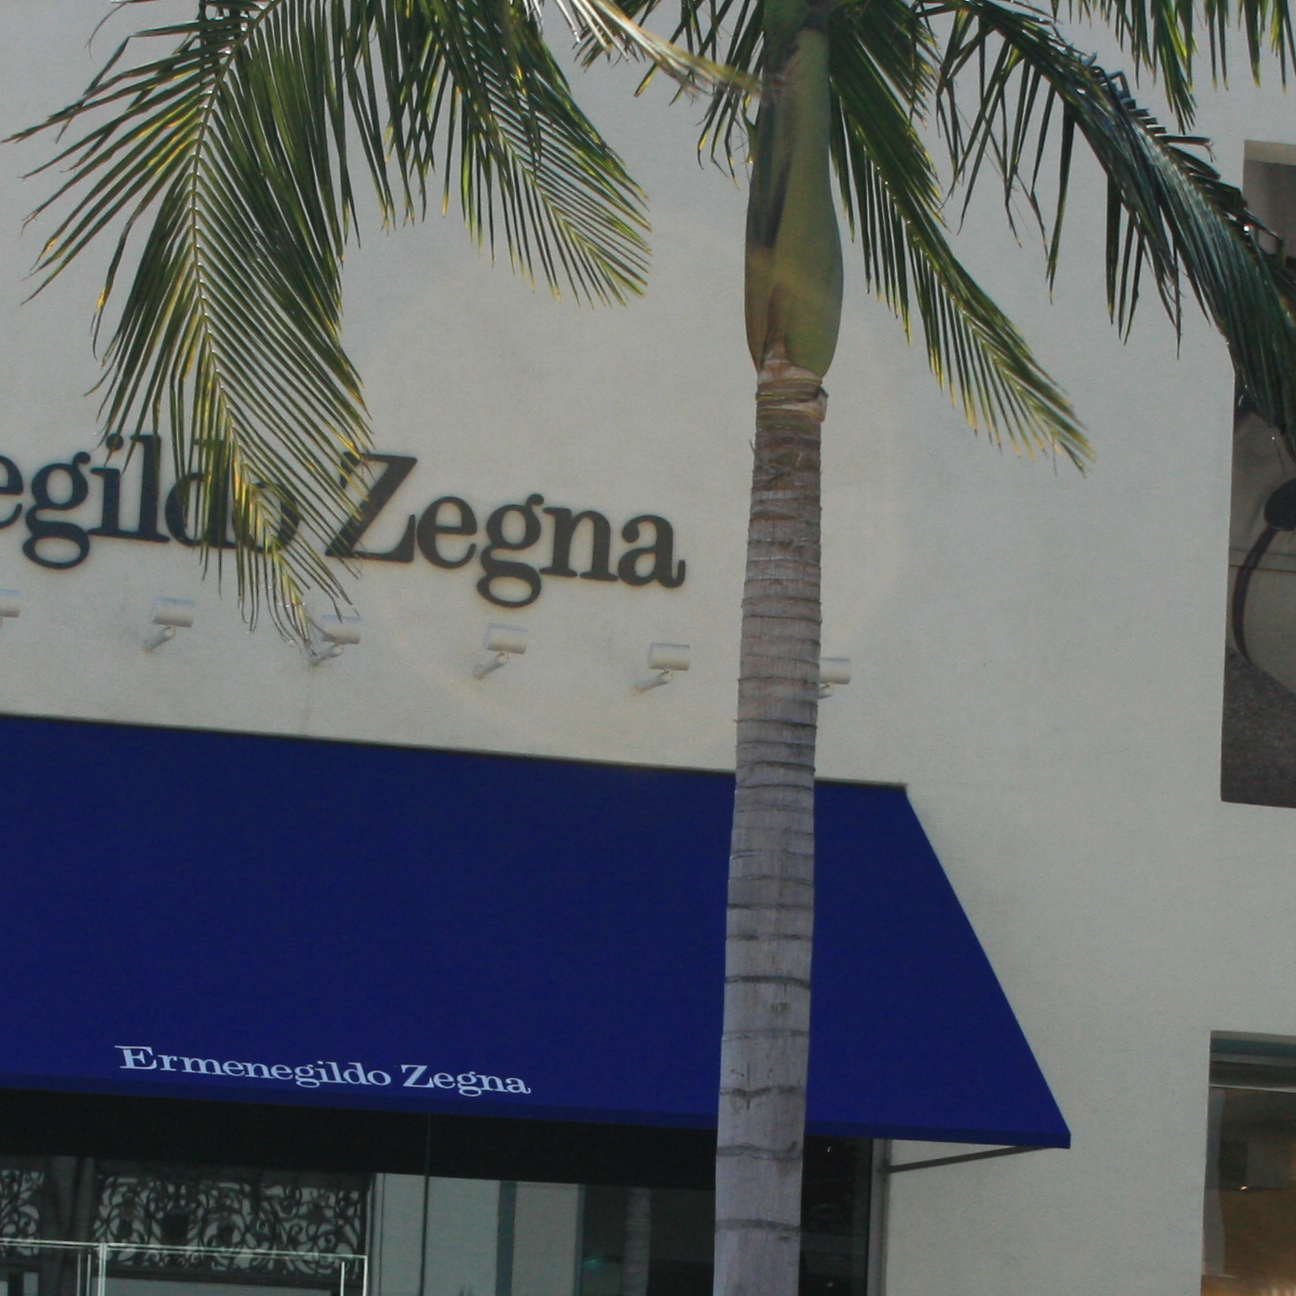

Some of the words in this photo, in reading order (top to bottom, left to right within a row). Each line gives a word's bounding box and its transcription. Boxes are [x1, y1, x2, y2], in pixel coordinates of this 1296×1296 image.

[324, 451, 687, 609] Zegna
[114, 1045, 391, 1088] Ermenegildo
[400, 1064, 532, 1097] Zegna
